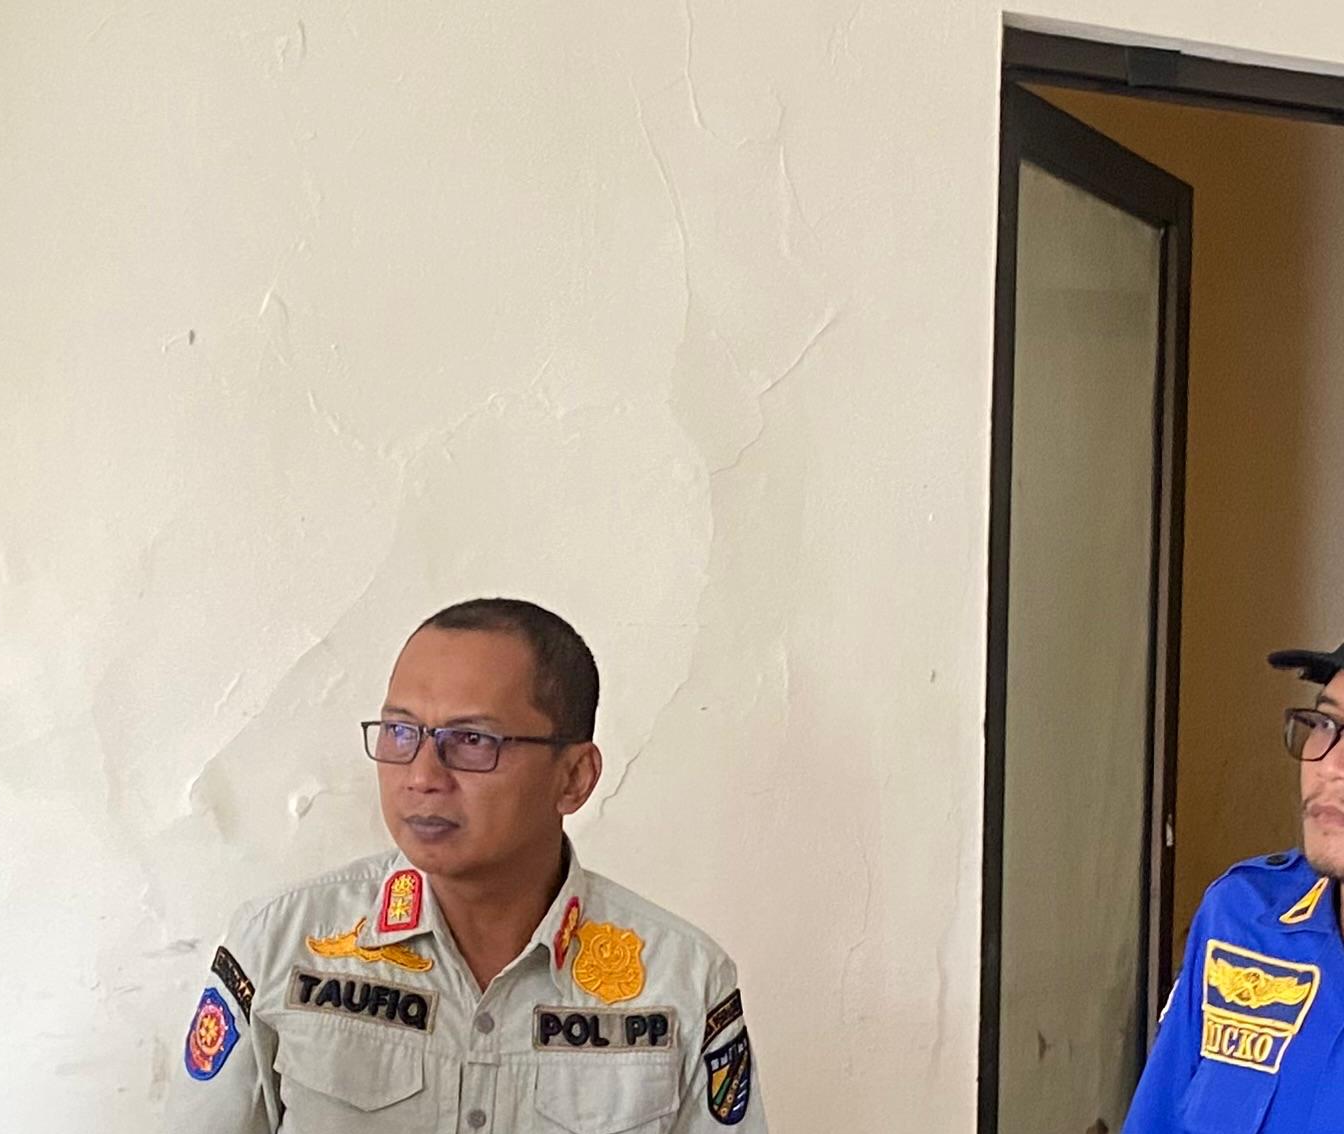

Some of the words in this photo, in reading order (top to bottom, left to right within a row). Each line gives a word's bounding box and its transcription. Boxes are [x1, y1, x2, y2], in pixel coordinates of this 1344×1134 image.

[298, 973, 429, 1031] TAUFIQ
[540, 1012, 610, 1047] POL
[625, 1012, 669, 1047] PP
